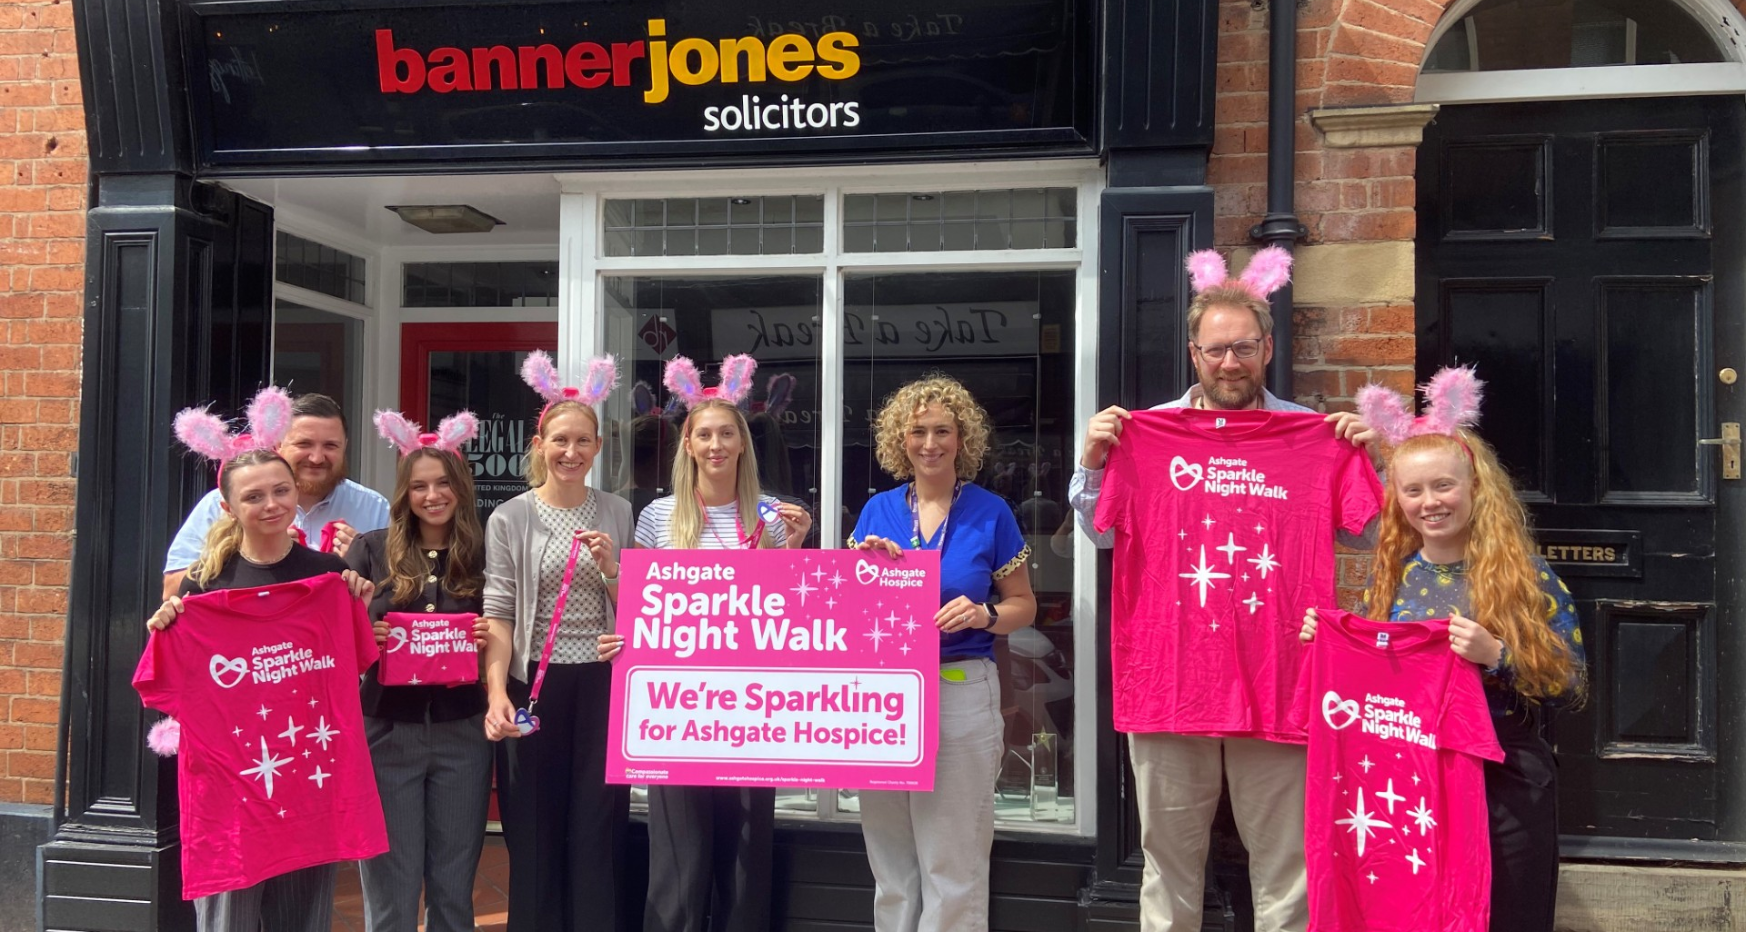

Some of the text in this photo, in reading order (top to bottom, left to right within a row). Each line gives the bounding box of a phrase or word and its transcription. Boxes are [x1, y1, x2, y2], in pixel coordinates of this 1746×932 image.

[703, 94, 860, 132] solicitors
[1208, 456, 1247, 467] Ashgate
[1207, 466, 1265, 483] Sparkle
[1204, 480, 1288, 500] Night Walk
[1536, 545, 1616, 562] LETTERS
[645, 561, 735, 585] Ashgate
[879, 577, 923, 589] Hospice
[881, 567, 926, 581] Ashgate
[640, 583, 785, 624] Sparkle
[412, 619, 449, 629] Ashgate
[411, 627, 466, 644] Sparkle
[632, 617, 848, 658] Night Walk
[251, 641, 293, 656] Ashgate
[409, 640, 478, 657] Night Wal
[252, 648, 313, 671] Sparkle
[252, 655, 335, 684] Night Walk
[745, 682, 904, 720] Sparkling
[1365, 693, 1405, 707] Ashgate
[1364, 704, 1421, 728] Sparkle
[639, 718, 906, 750] for Ashgate Hospice!
[1362, 718, 1404, 739] Night
